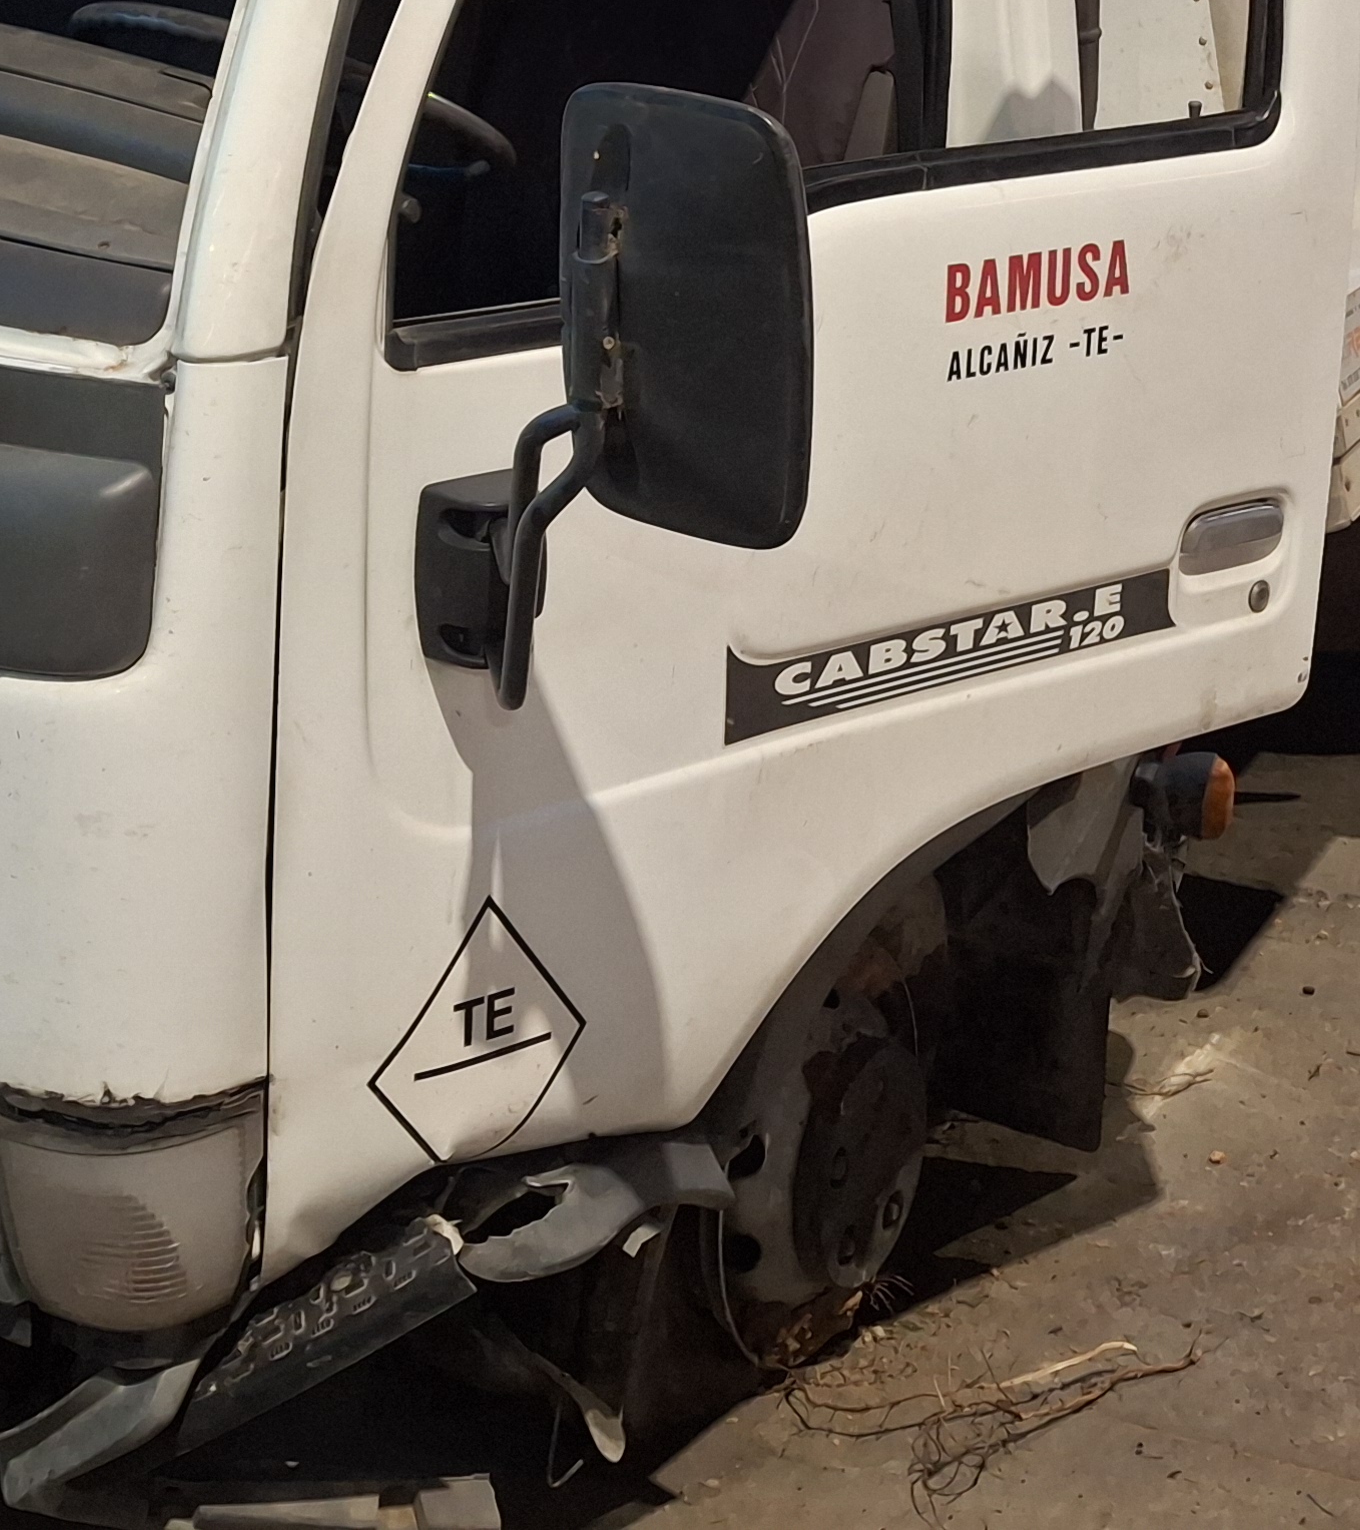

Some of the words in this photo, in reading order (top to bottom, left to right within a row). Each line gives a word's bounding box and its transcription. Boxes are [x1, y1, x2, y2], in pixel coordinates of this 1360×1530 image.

[944, 239, 1130, 323] BAMUSA
[946, 331, 1055, 382] ALCAÑIZ
[1068, 324, 1124, 358] -TE-
[774, 583, 1123, 696] CABSTAR.E
[1067, 615, 1125, 650] 120
[452, 986, 516, 1048] TE
